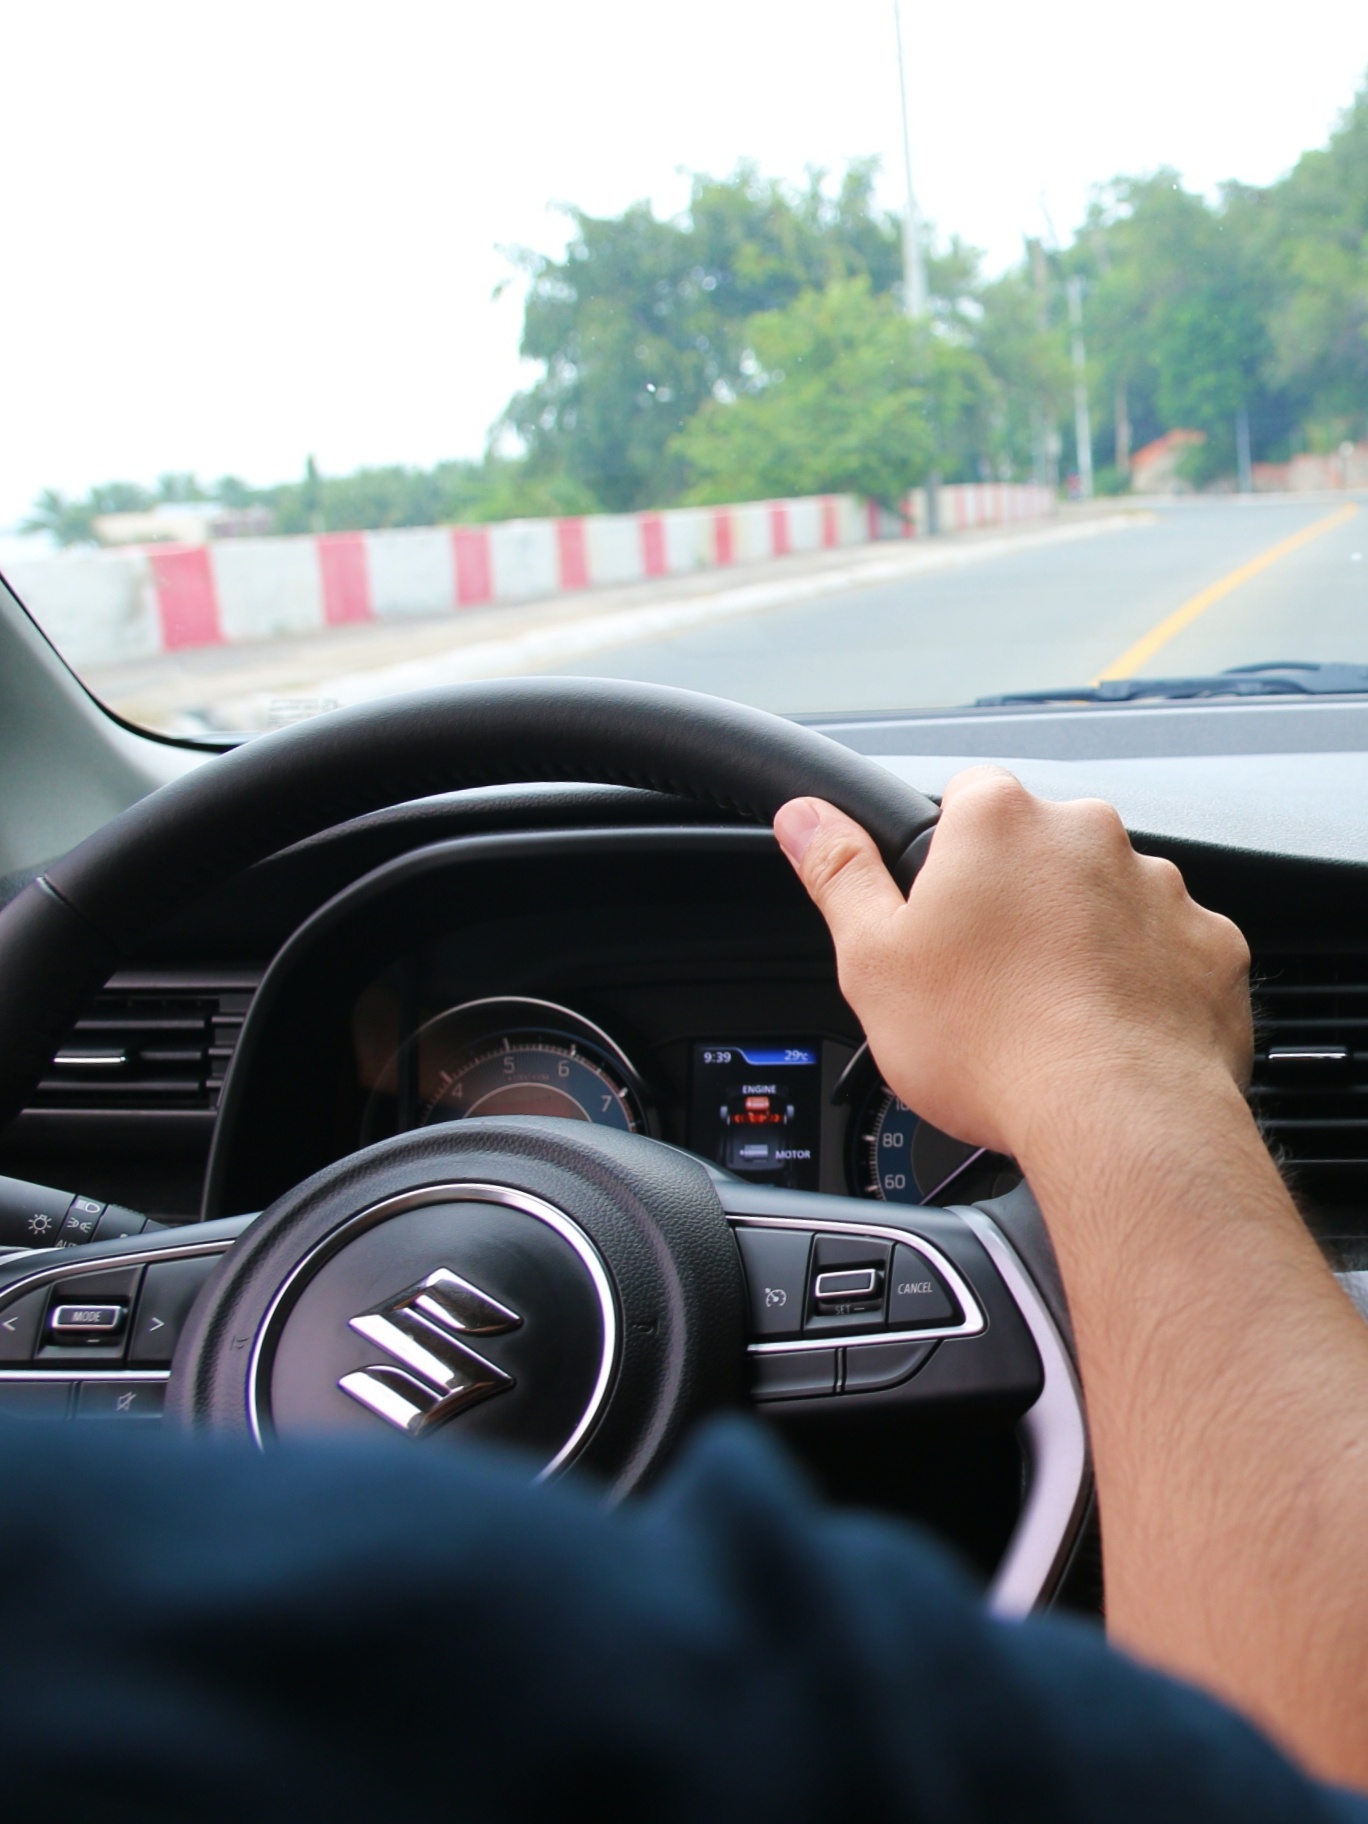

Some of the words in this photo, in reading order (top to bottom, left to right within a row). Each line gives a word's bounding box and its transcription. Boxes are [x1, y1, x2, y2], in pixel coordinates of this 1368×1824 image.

[703, 1051, 732, 1064] 9:39
[503, 1056, 515, 1075] 5
[558, 1060, 570, 1077] 6
[741, 1084, 776, 1095] ENGINE
[882, 1132, 904, 1148] 80
[775, 1149, 811, 1160] MOTOR
[884, 1173, 906, 1190] 60
[897, 1281, 933, 1295] CANCEL
[72, 1311, 101, 1322] MODE
[835, 1305, 851, 1315] SET
